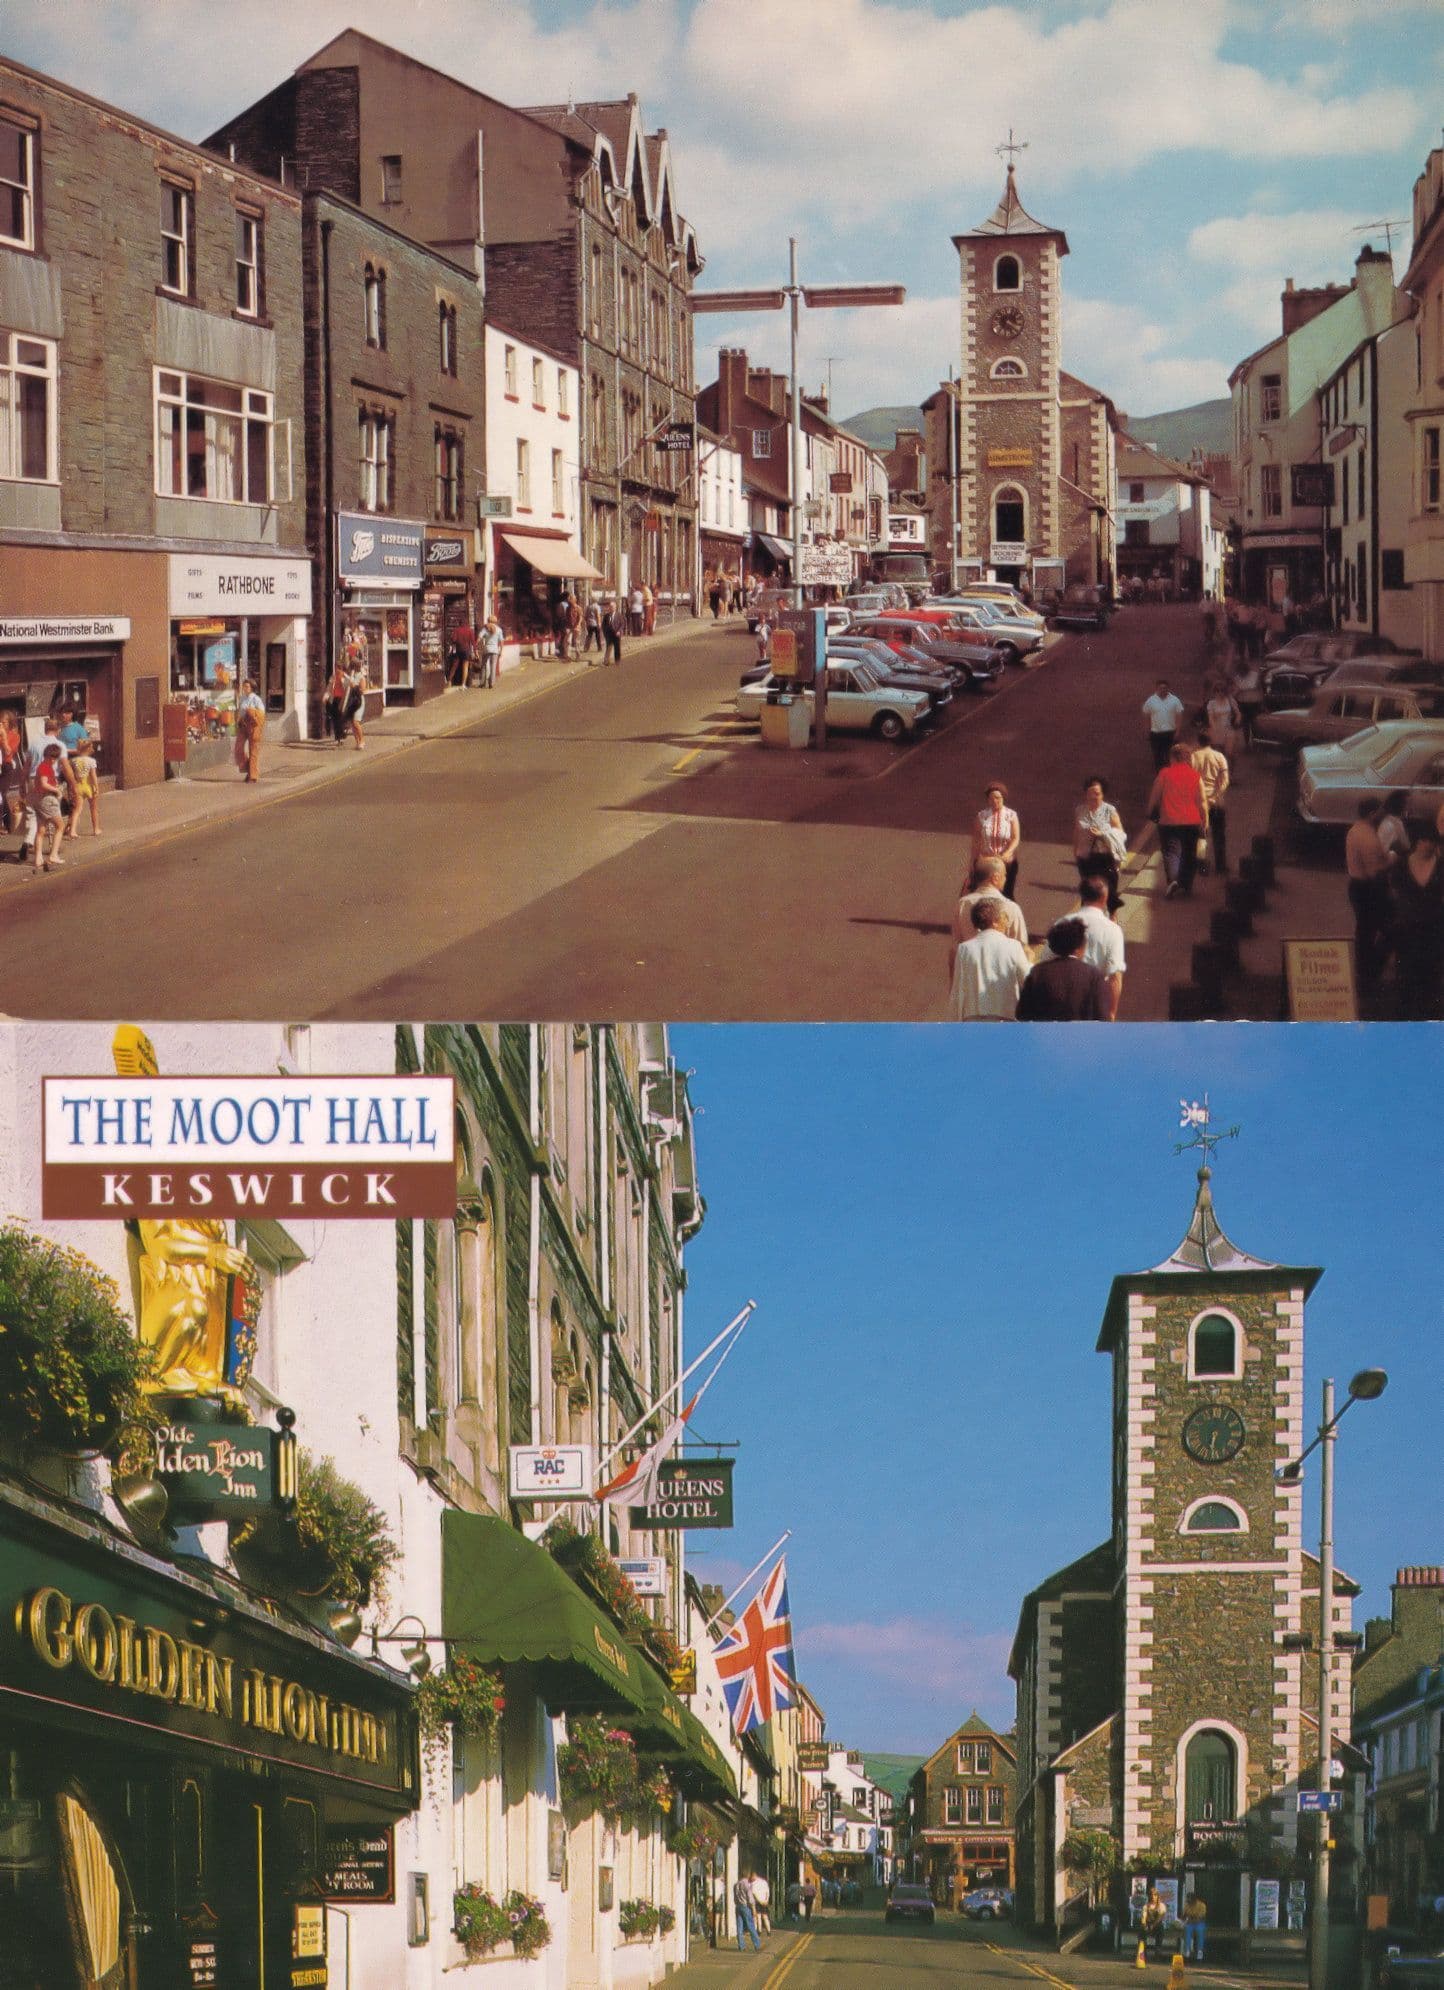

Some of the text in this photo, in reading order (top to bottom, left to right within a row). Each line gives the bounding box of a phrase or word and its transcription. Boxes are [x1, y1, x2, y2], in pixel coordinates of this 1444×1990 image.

[667, 441, 691, 449] HOTEL
[383, 554, 418, 567] CHEMISTS
[187, 568, 202, 577] GIFTS
[218, 575, 275, 595] RATHBONE
[187, 592, 203, 600] FILMS
[0, 622, 114, 638] National Westminster Bank
[208, 1439, 266, 1477] Lion
[533, 1459, 565, 1476] RAC
[219, 1477, 258, 1498] Inn
[657, 1479, 724, 1498] UEENS
[646, 1501, 718, 1519] HOTEL
[30, 1587, 388, 1764] GOLDEN LION INN
[1193, 1831, 1245, 1841] BOOKING
[334, 1871, 368, 1881] MEALS
[343, 1880, 375, 1890] ROOM
